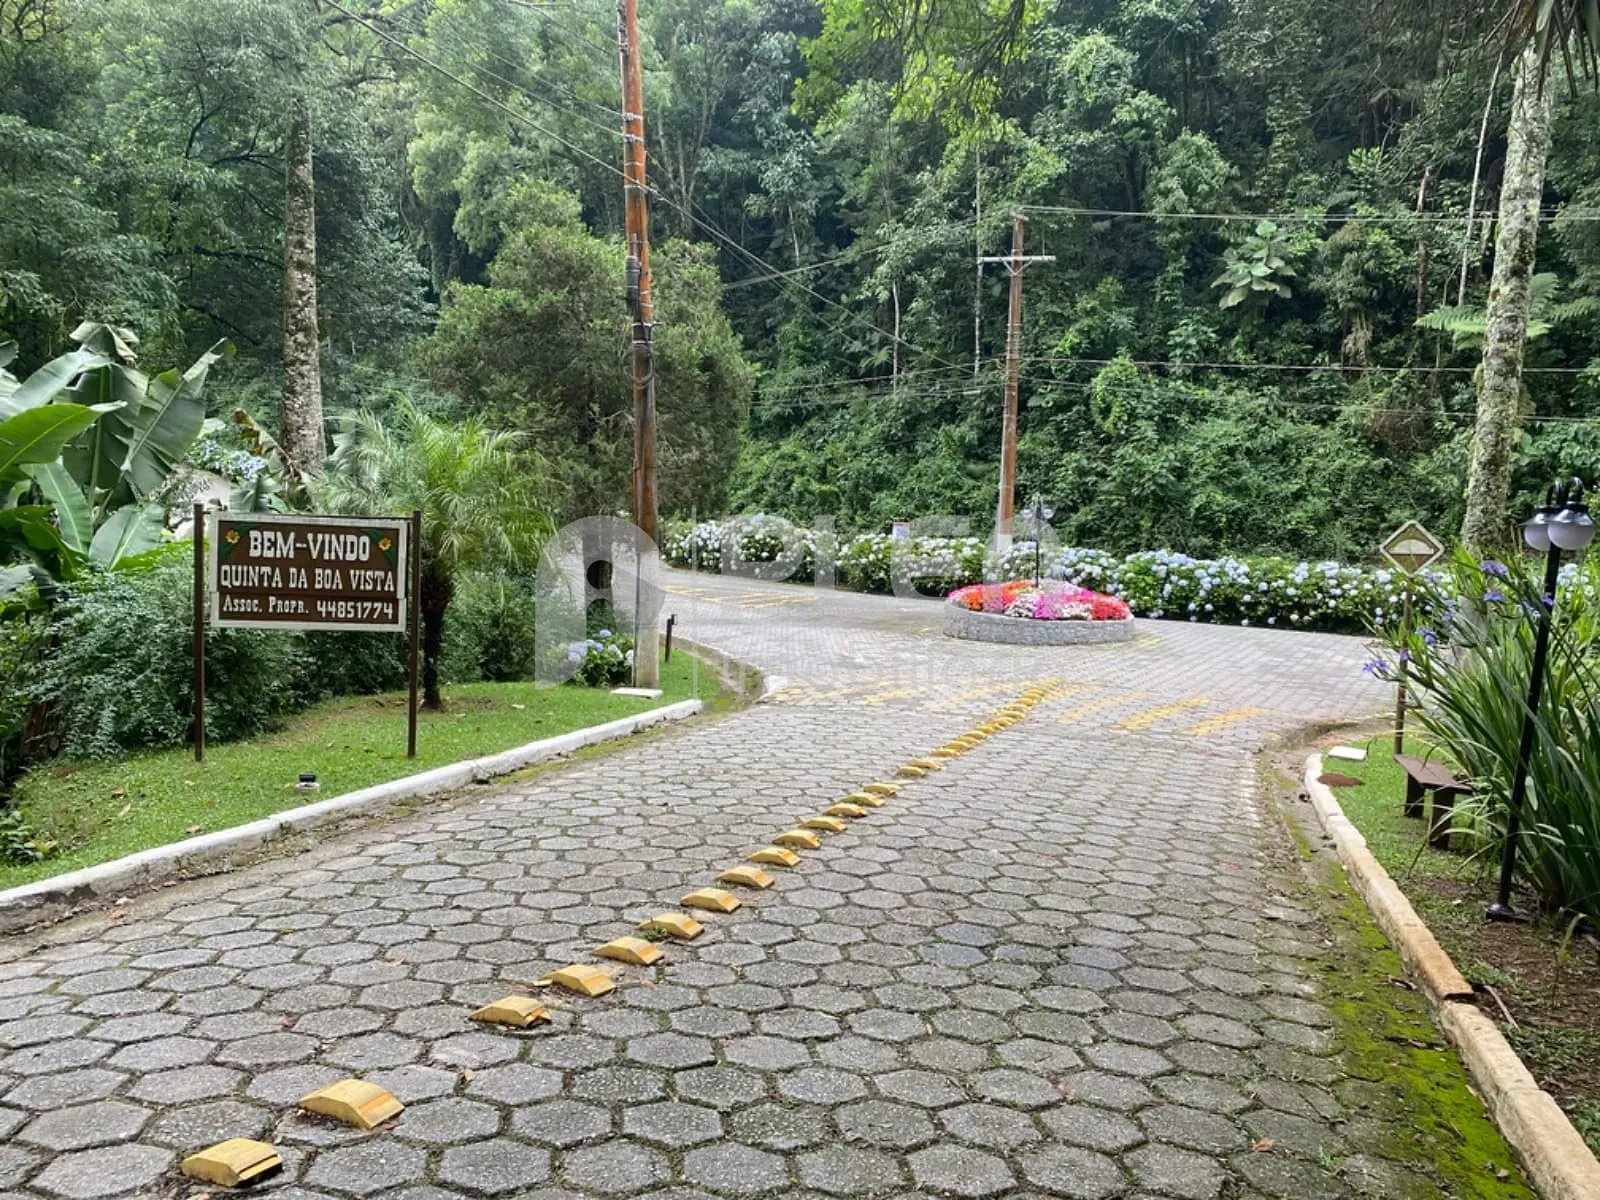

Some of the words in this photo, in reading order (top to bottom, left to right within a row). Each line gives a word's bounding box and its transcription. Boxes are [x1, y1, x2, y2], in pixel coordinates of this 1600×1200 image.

[249, 529, 371, 561] BEM-VINDO
[220, 564, 283, 588] QUINTA
[288, 567, 308, 589] DA
[314, 568, 343, 590] BOA
[350, 570, 395, 592] VISTA
[316, 599, 393, 620] 44851774
